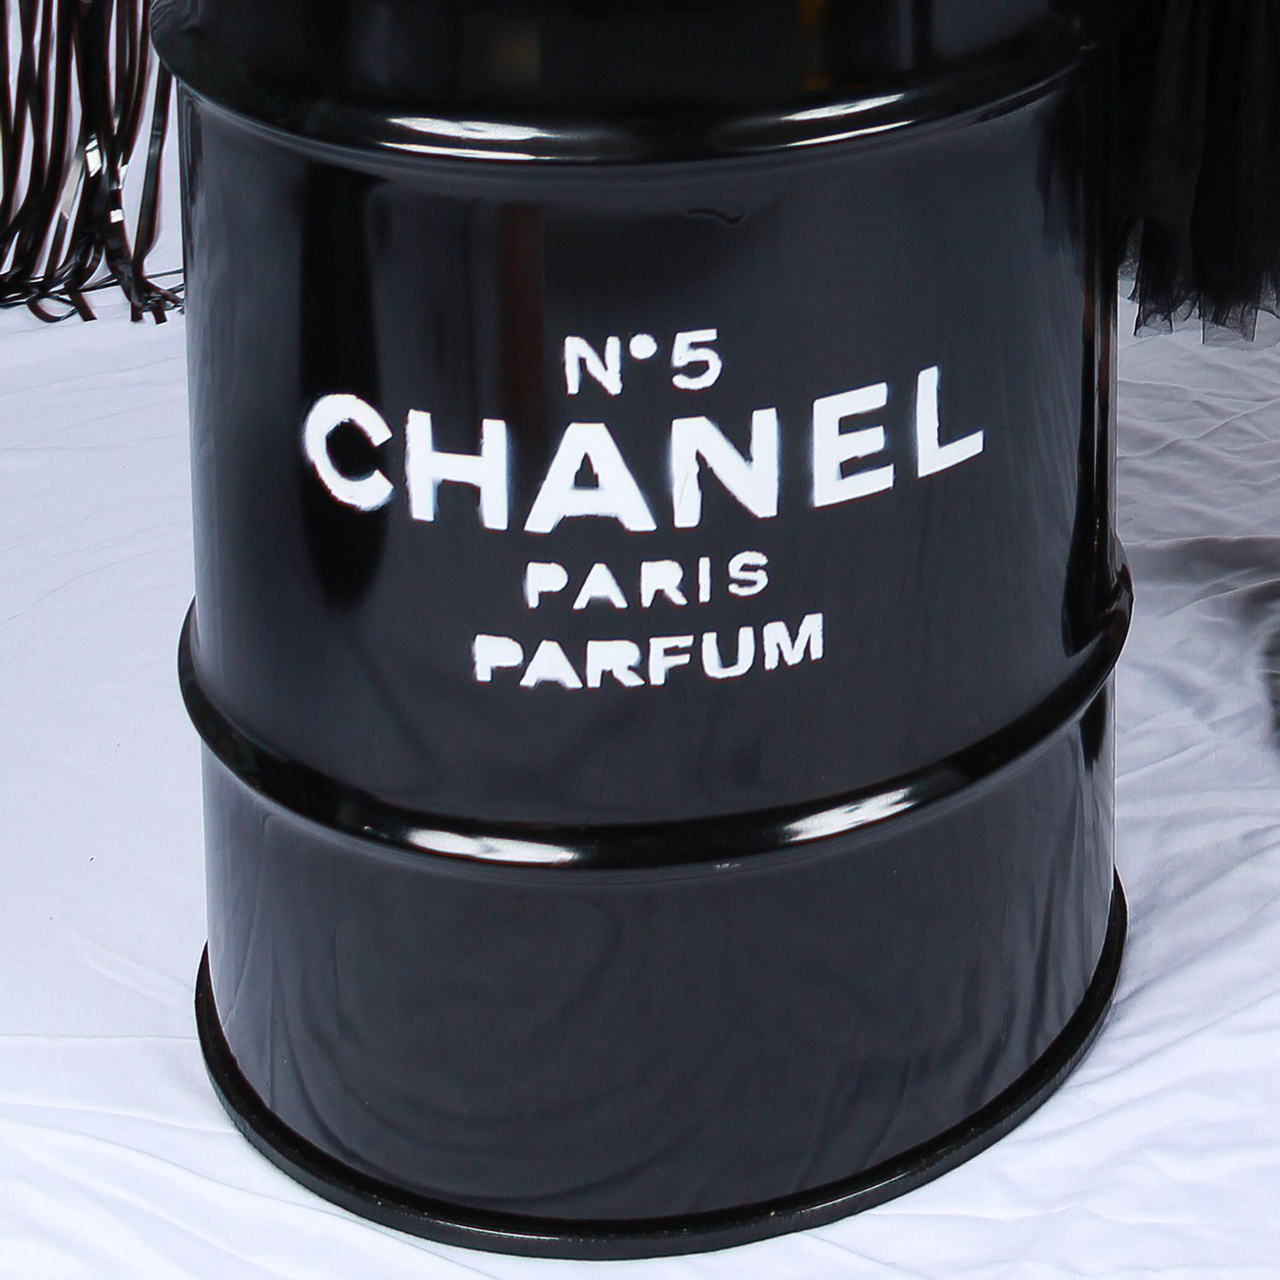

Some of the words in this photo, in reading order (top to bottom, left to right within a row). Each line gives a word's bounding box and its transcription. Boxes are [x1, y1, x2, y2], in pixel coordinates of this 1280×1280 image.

[303, 365, 984, 534] CHANEL
[524, 550, 769, 610] PARIS
[472, 612, 824, 689] PARFUM
